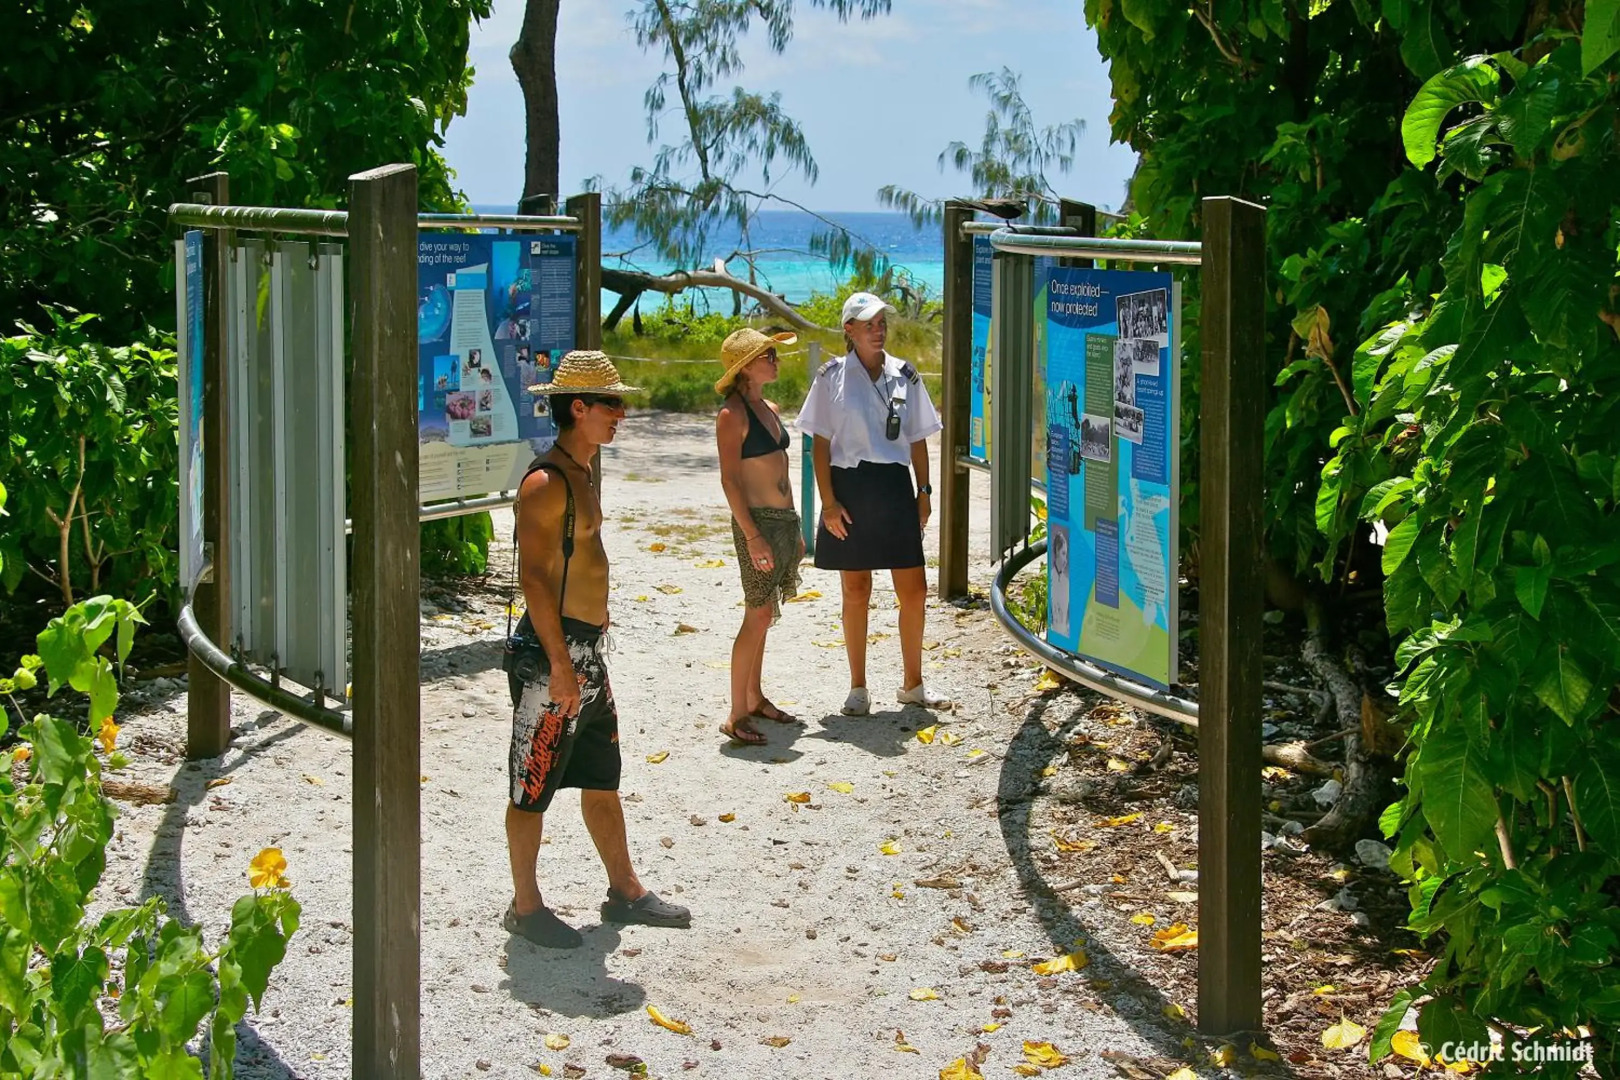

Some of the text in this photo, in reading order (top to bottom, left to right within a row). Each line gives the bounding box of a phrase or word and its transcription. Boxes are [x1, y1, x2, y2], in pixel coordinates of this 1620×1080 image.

[420, 242, 432, 251] dive
[434, 243, 447, 253] your
[462, 242, 469, 251] to
[434, 253, 441, 263] of
[442, 253, 452, 263] the
[453, 253, 466, 263] reef
[1051, 279, 1068, 295] Once
[1051, 301, 1097, 317] now protected
